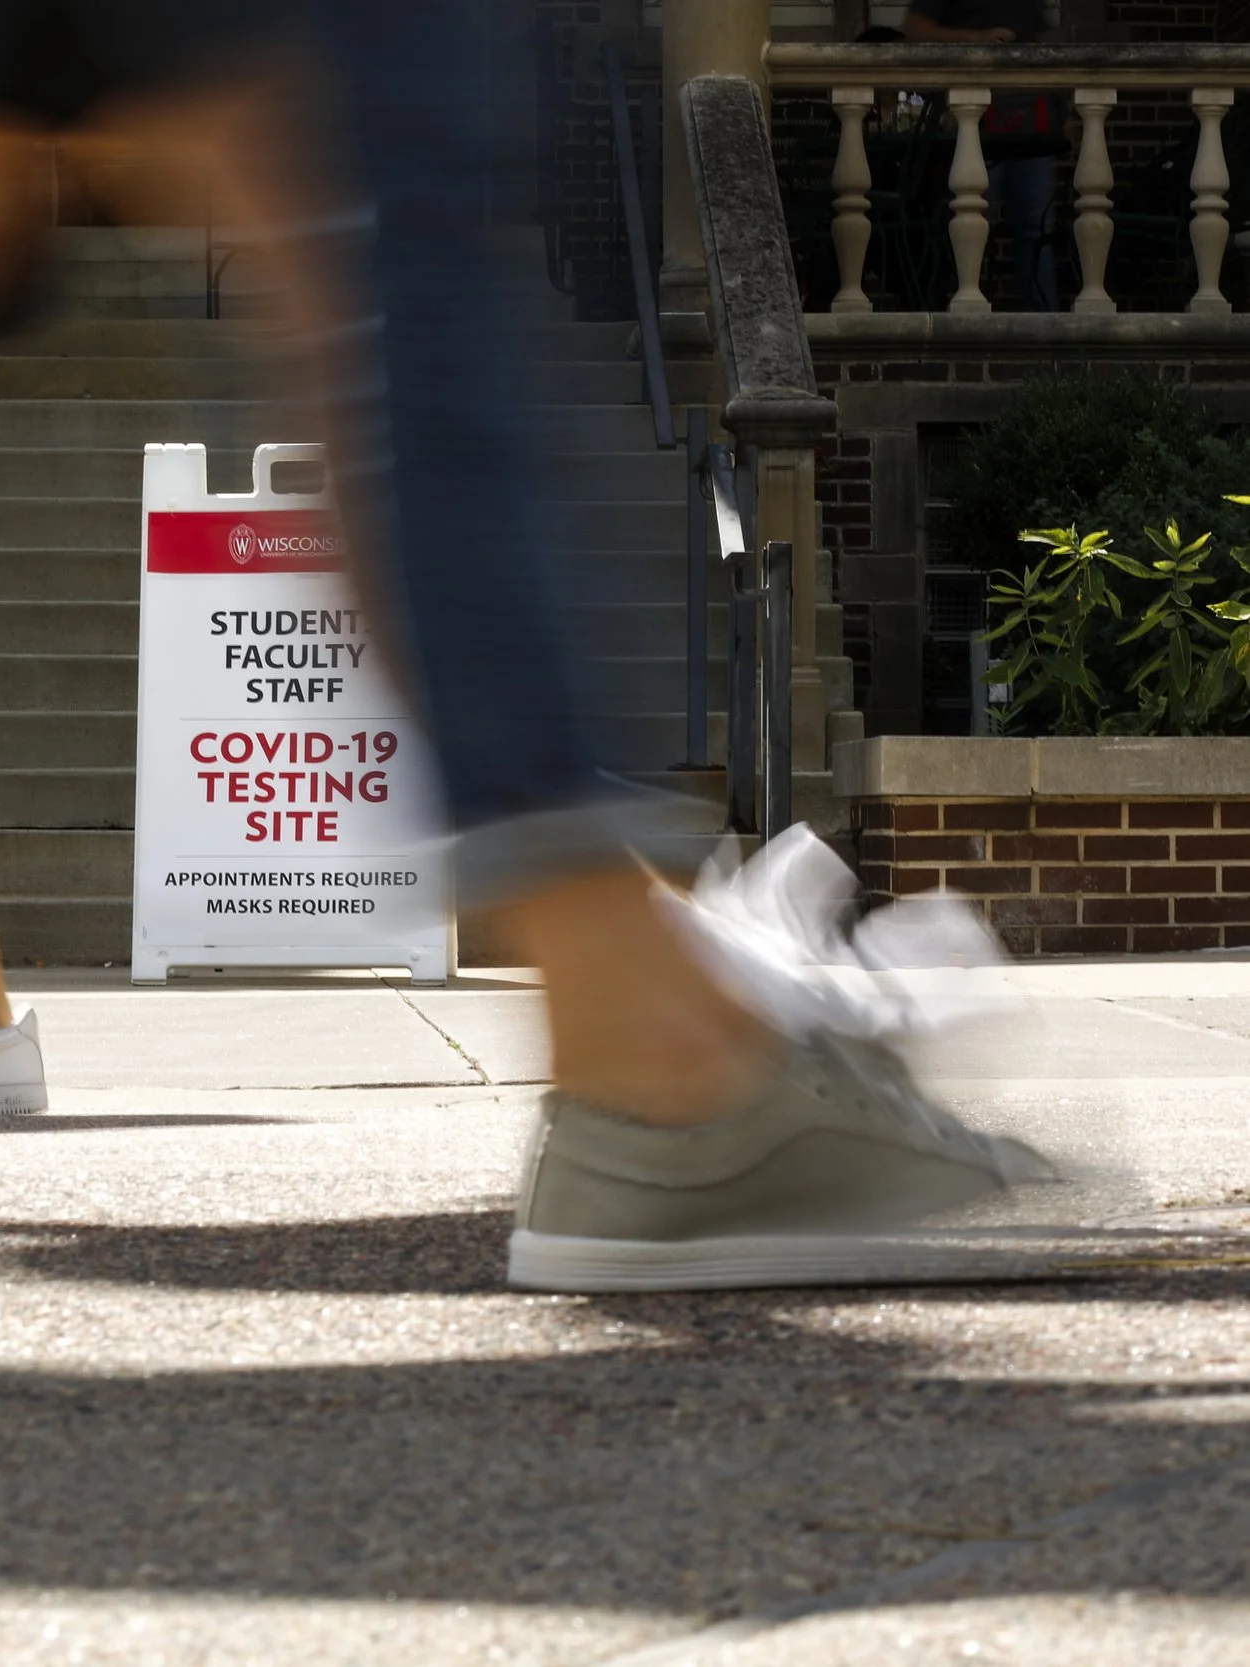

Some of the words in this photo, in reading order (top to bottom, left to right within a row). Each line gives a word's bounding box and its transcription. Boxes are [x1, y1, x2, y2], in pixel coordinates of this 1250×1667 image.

[211, 610, 371, 635] STUDENT
[226, 644, 366, 669] FACULTY
[246, 678, 343, 703] STAFF
[190, 731, 398, 764] COVID-19
[197, 771, 388, 803] TESTING
[245, 811, 338, 842] SITE
[165, 872, 316, 887] APPOINTMENTS
[321, 871, 418, 888] REQUIRED
[206, 899, 273, 914] MASKS
[278, 899, 375, 915] REQUIRED
